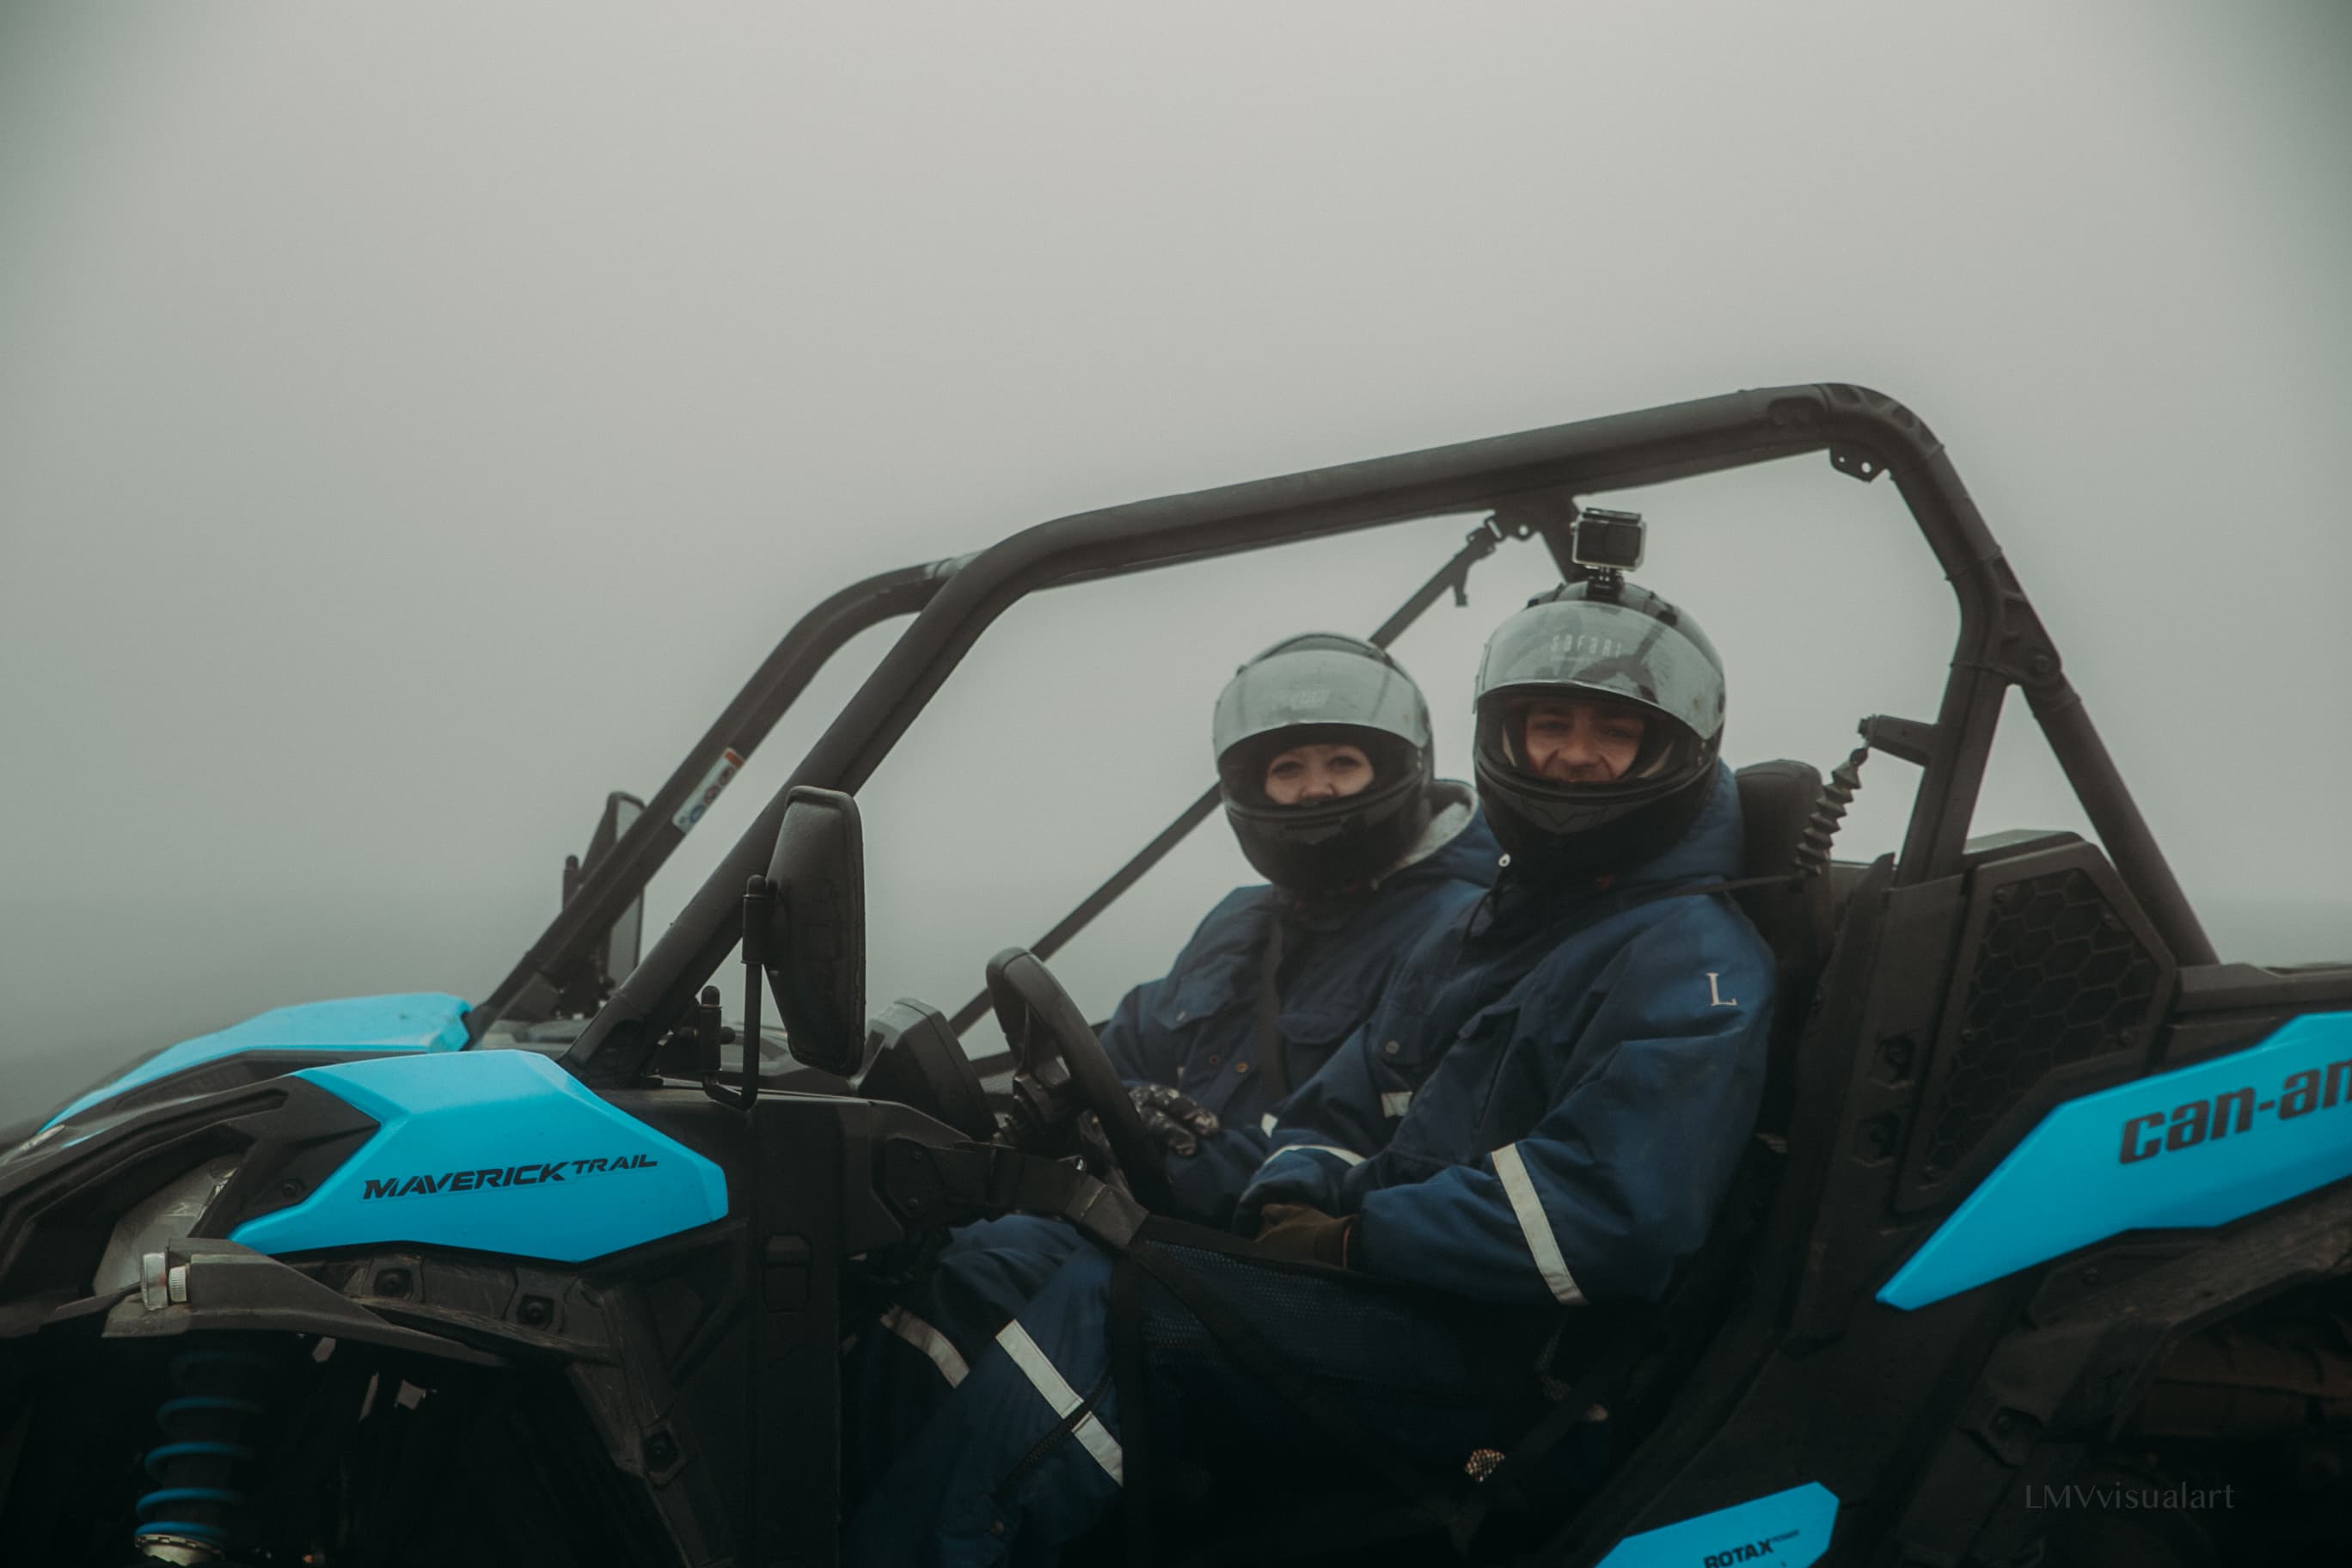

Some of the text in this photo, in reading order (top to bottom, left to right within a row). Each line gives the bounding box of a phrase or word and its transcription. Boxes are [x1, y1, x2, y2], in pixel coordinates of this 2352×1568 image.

[1706, 972, 1737, 1007] L
[363, 1154, 658, 1200] MAVERICK TRAIL
[1704, 1538, 1774, 1568] ROTAX
